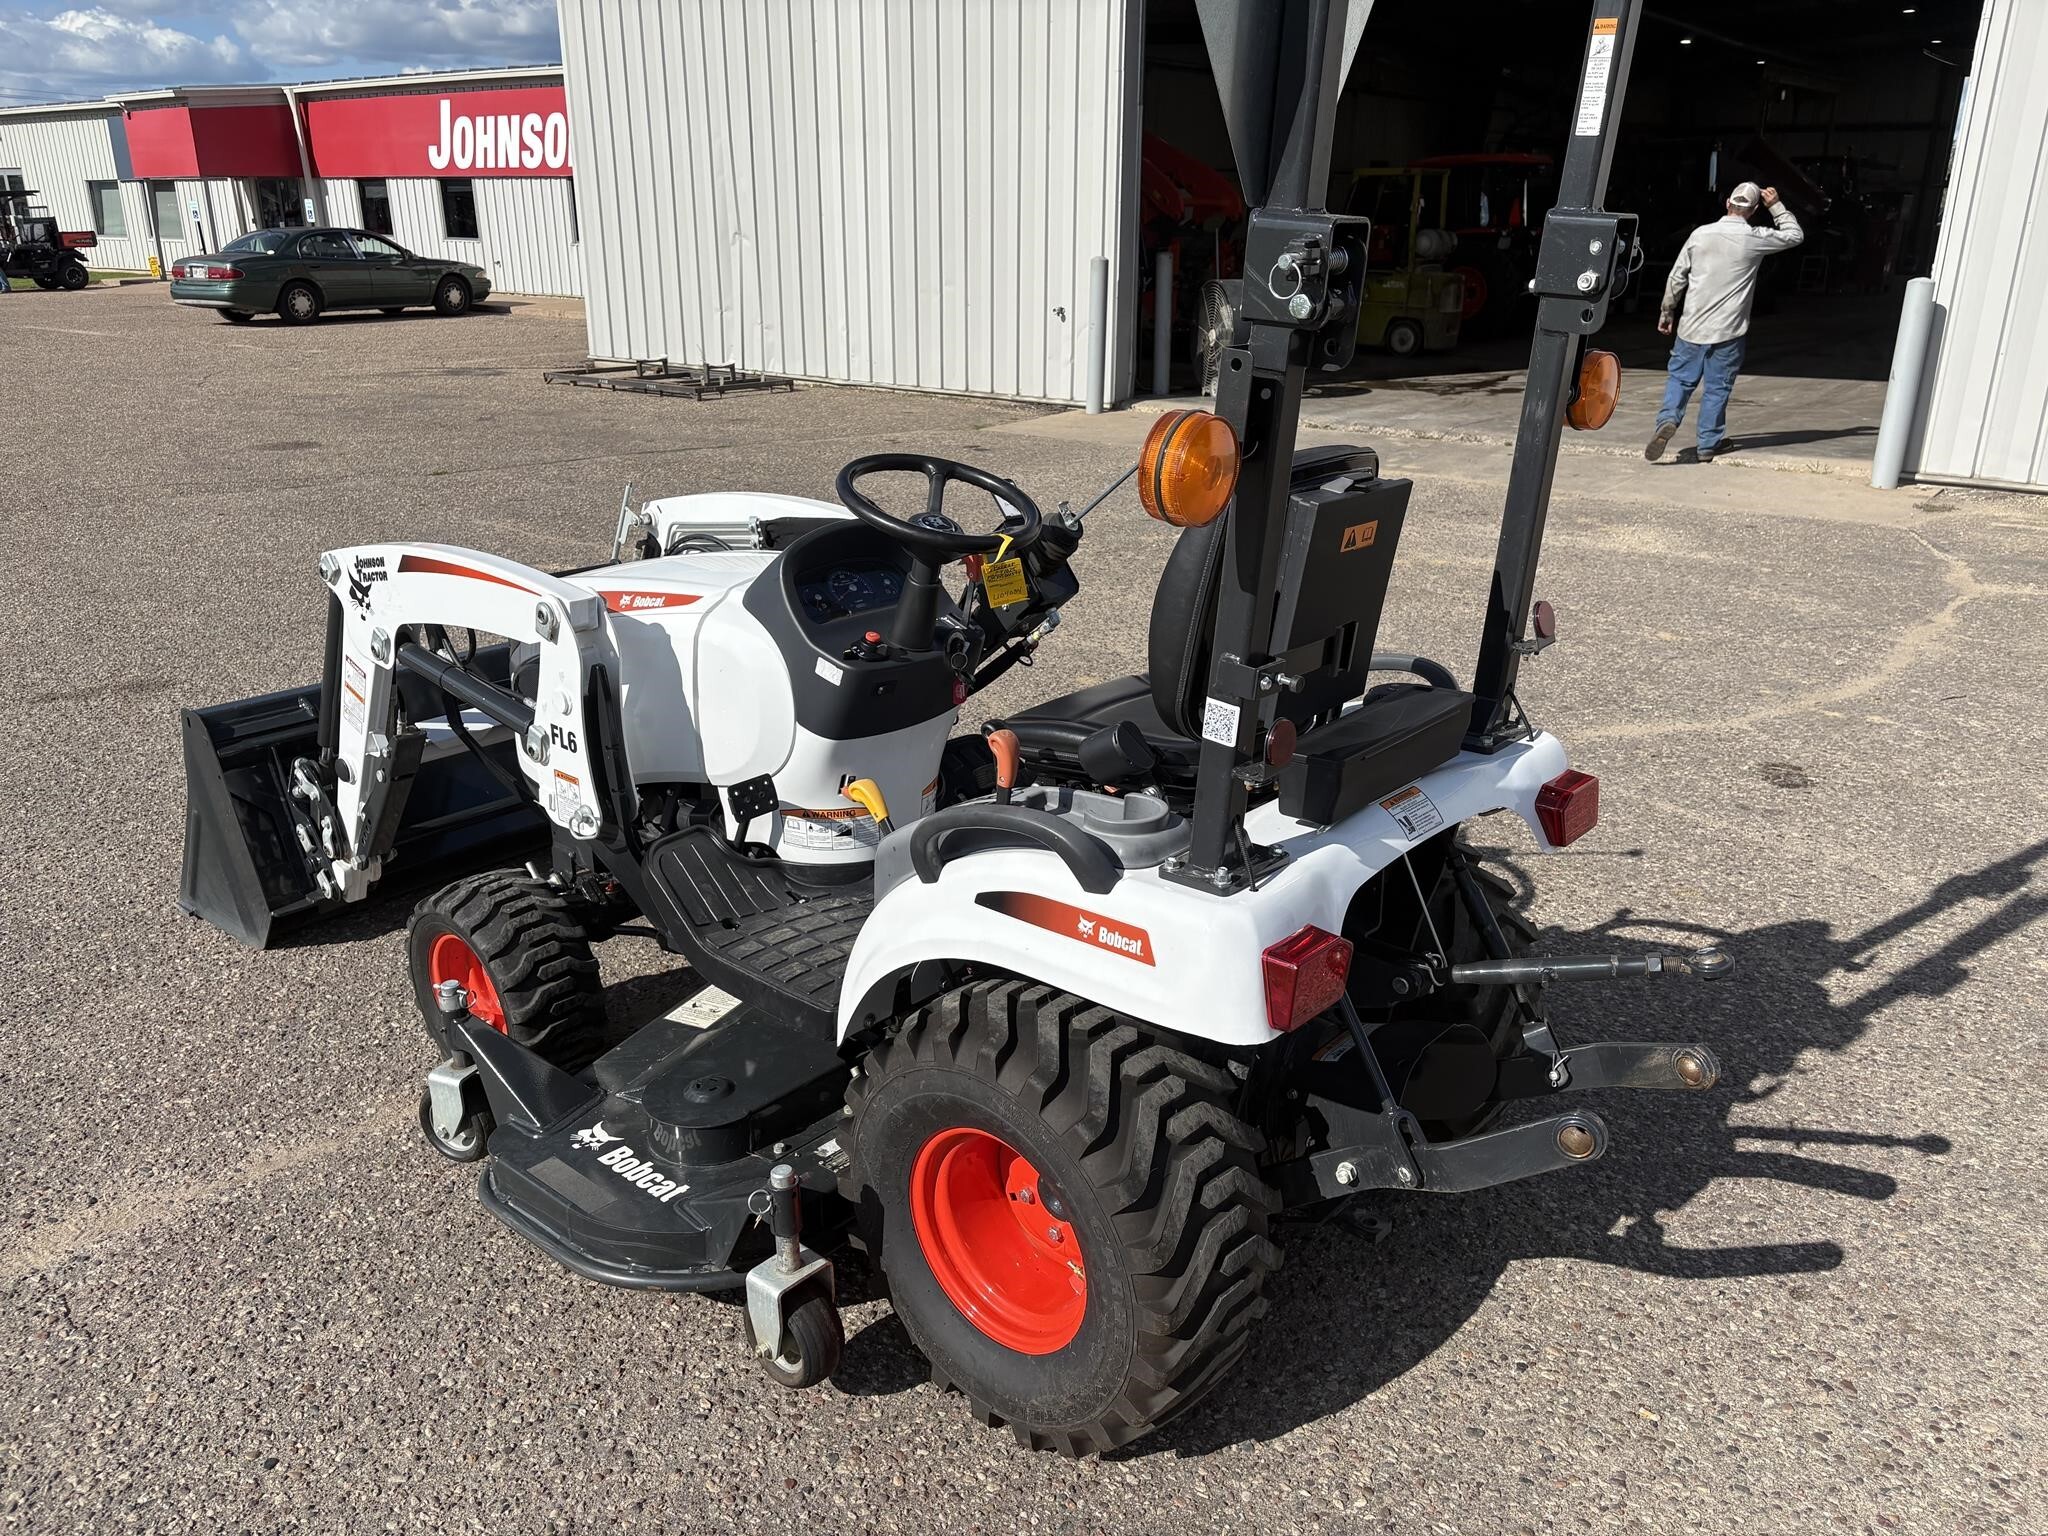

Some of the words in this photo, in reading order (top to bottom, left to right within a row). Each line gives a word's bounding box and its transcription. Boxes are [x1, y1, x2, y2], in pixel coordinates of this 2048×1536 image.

[428, 99, 573, 170] JOHNSO
[354, 555, 385, 569] JOHNSON
[357, 569, 388, 582] TRACTOR
[632, 596, 665, 608] Bobcat
[550, 723, 577, 753] FL6
[811, 809, 857, 819] WARNING
[1098, 926, 1144, 956] Bobcat
[597, 1145, 690, 1203] Bobcat
